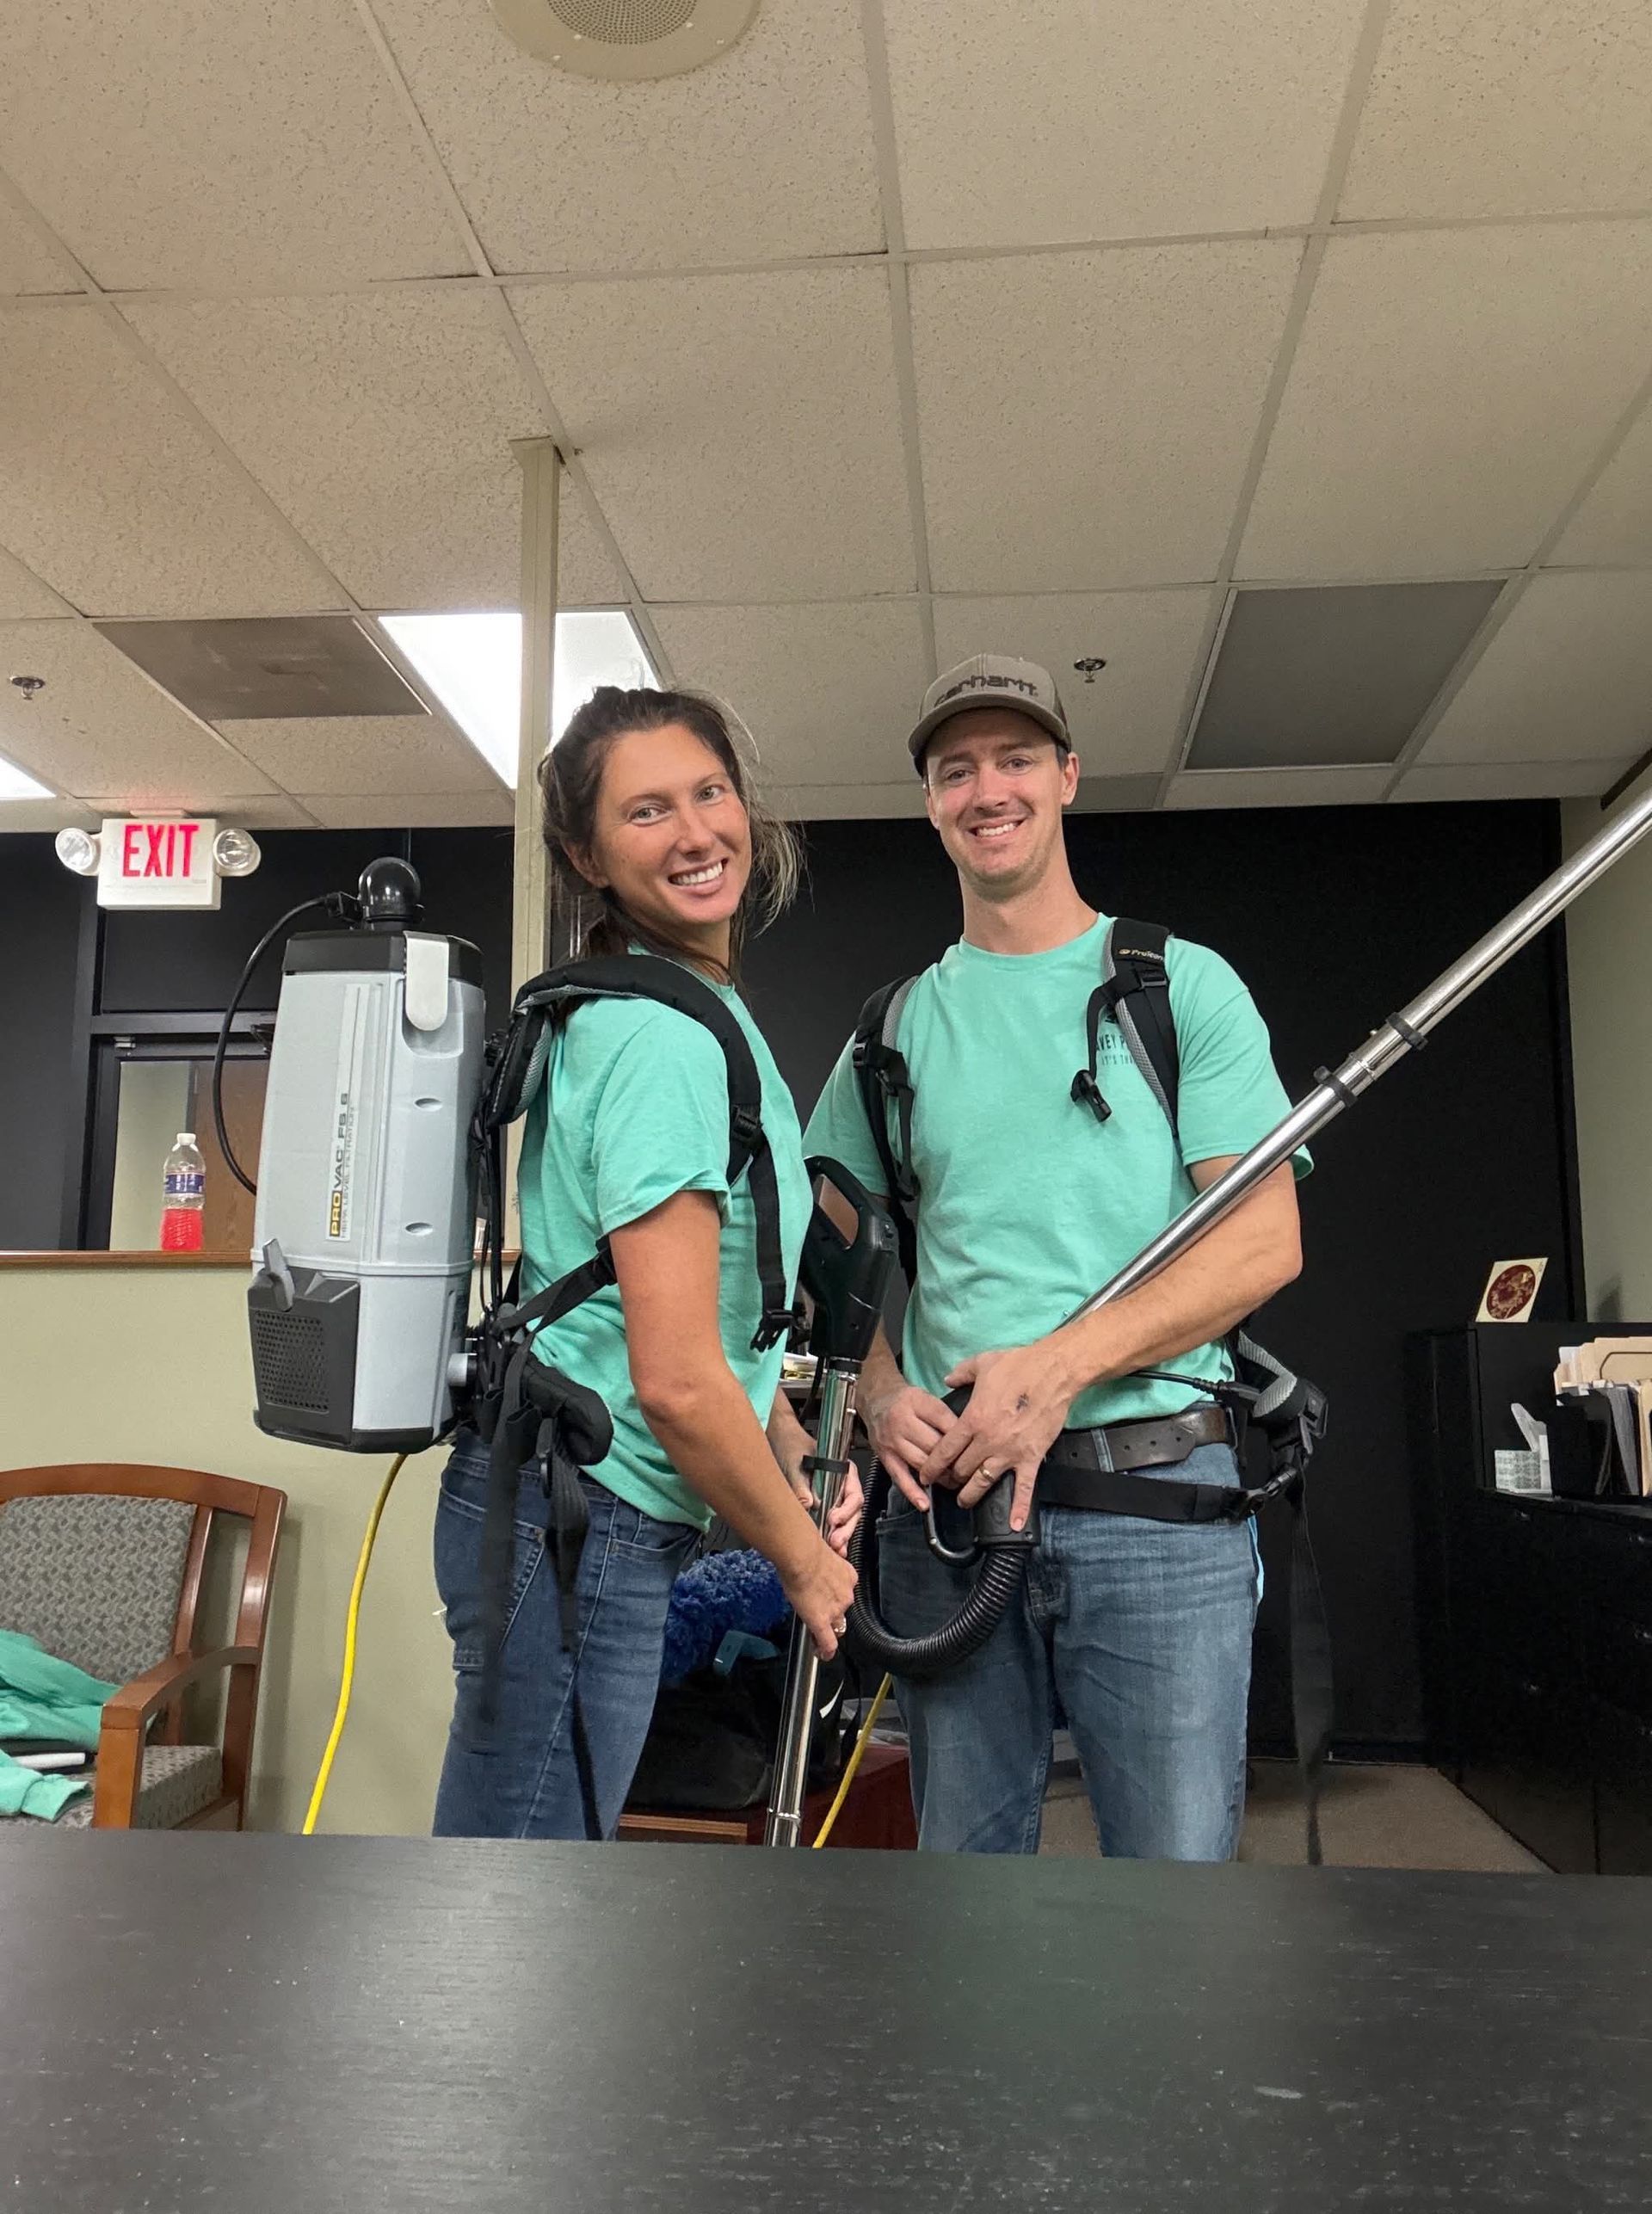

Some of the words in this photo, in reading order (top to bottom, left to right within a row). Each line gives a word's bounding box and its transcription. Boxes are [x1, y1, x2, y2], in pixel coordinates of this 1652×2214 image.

[122, 824, 200, 878] EXIT
[340, 1093, 348, 1106] 6
[337, 1113, 347, 1139] FS
[344, 1106, 355, 1168] FILTRATION
